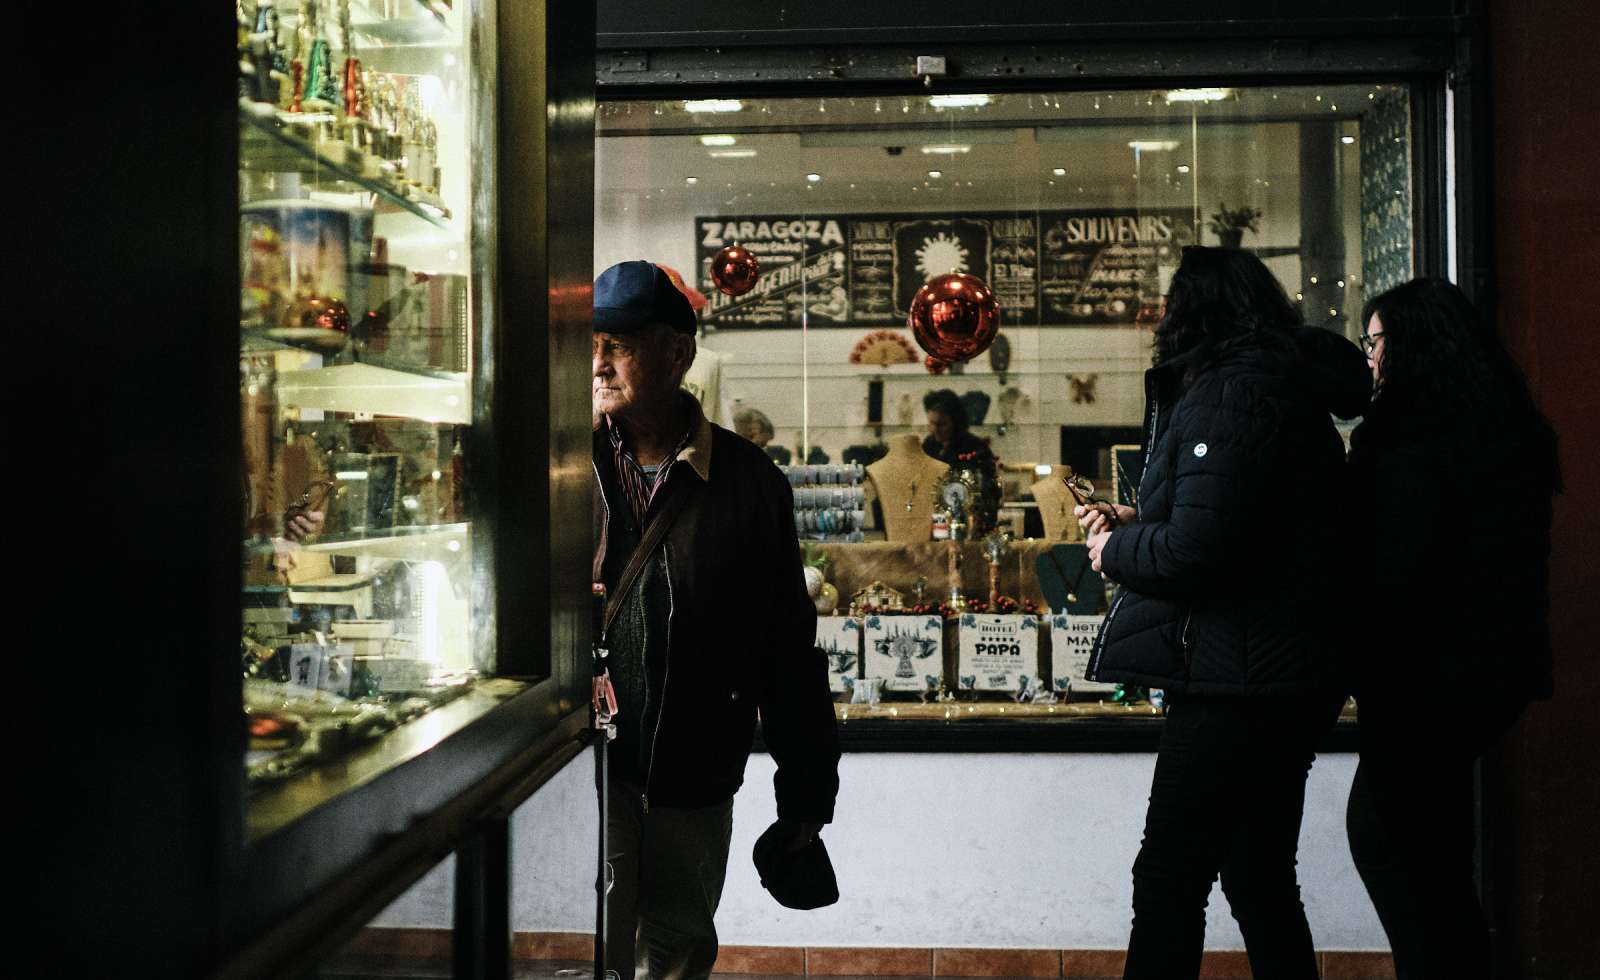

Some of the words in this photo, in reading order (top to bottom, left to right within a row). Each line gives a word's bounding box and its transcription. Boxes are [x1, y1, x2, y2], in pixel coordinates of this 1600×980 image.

[702, 220, 844, 246] ZARAGOZA
[1067, 215, 1171, 242] SOUVENIRS
[981, 624, 1014, 632] HOTEL
[975, 639, 1020, 656] PAPÁ
